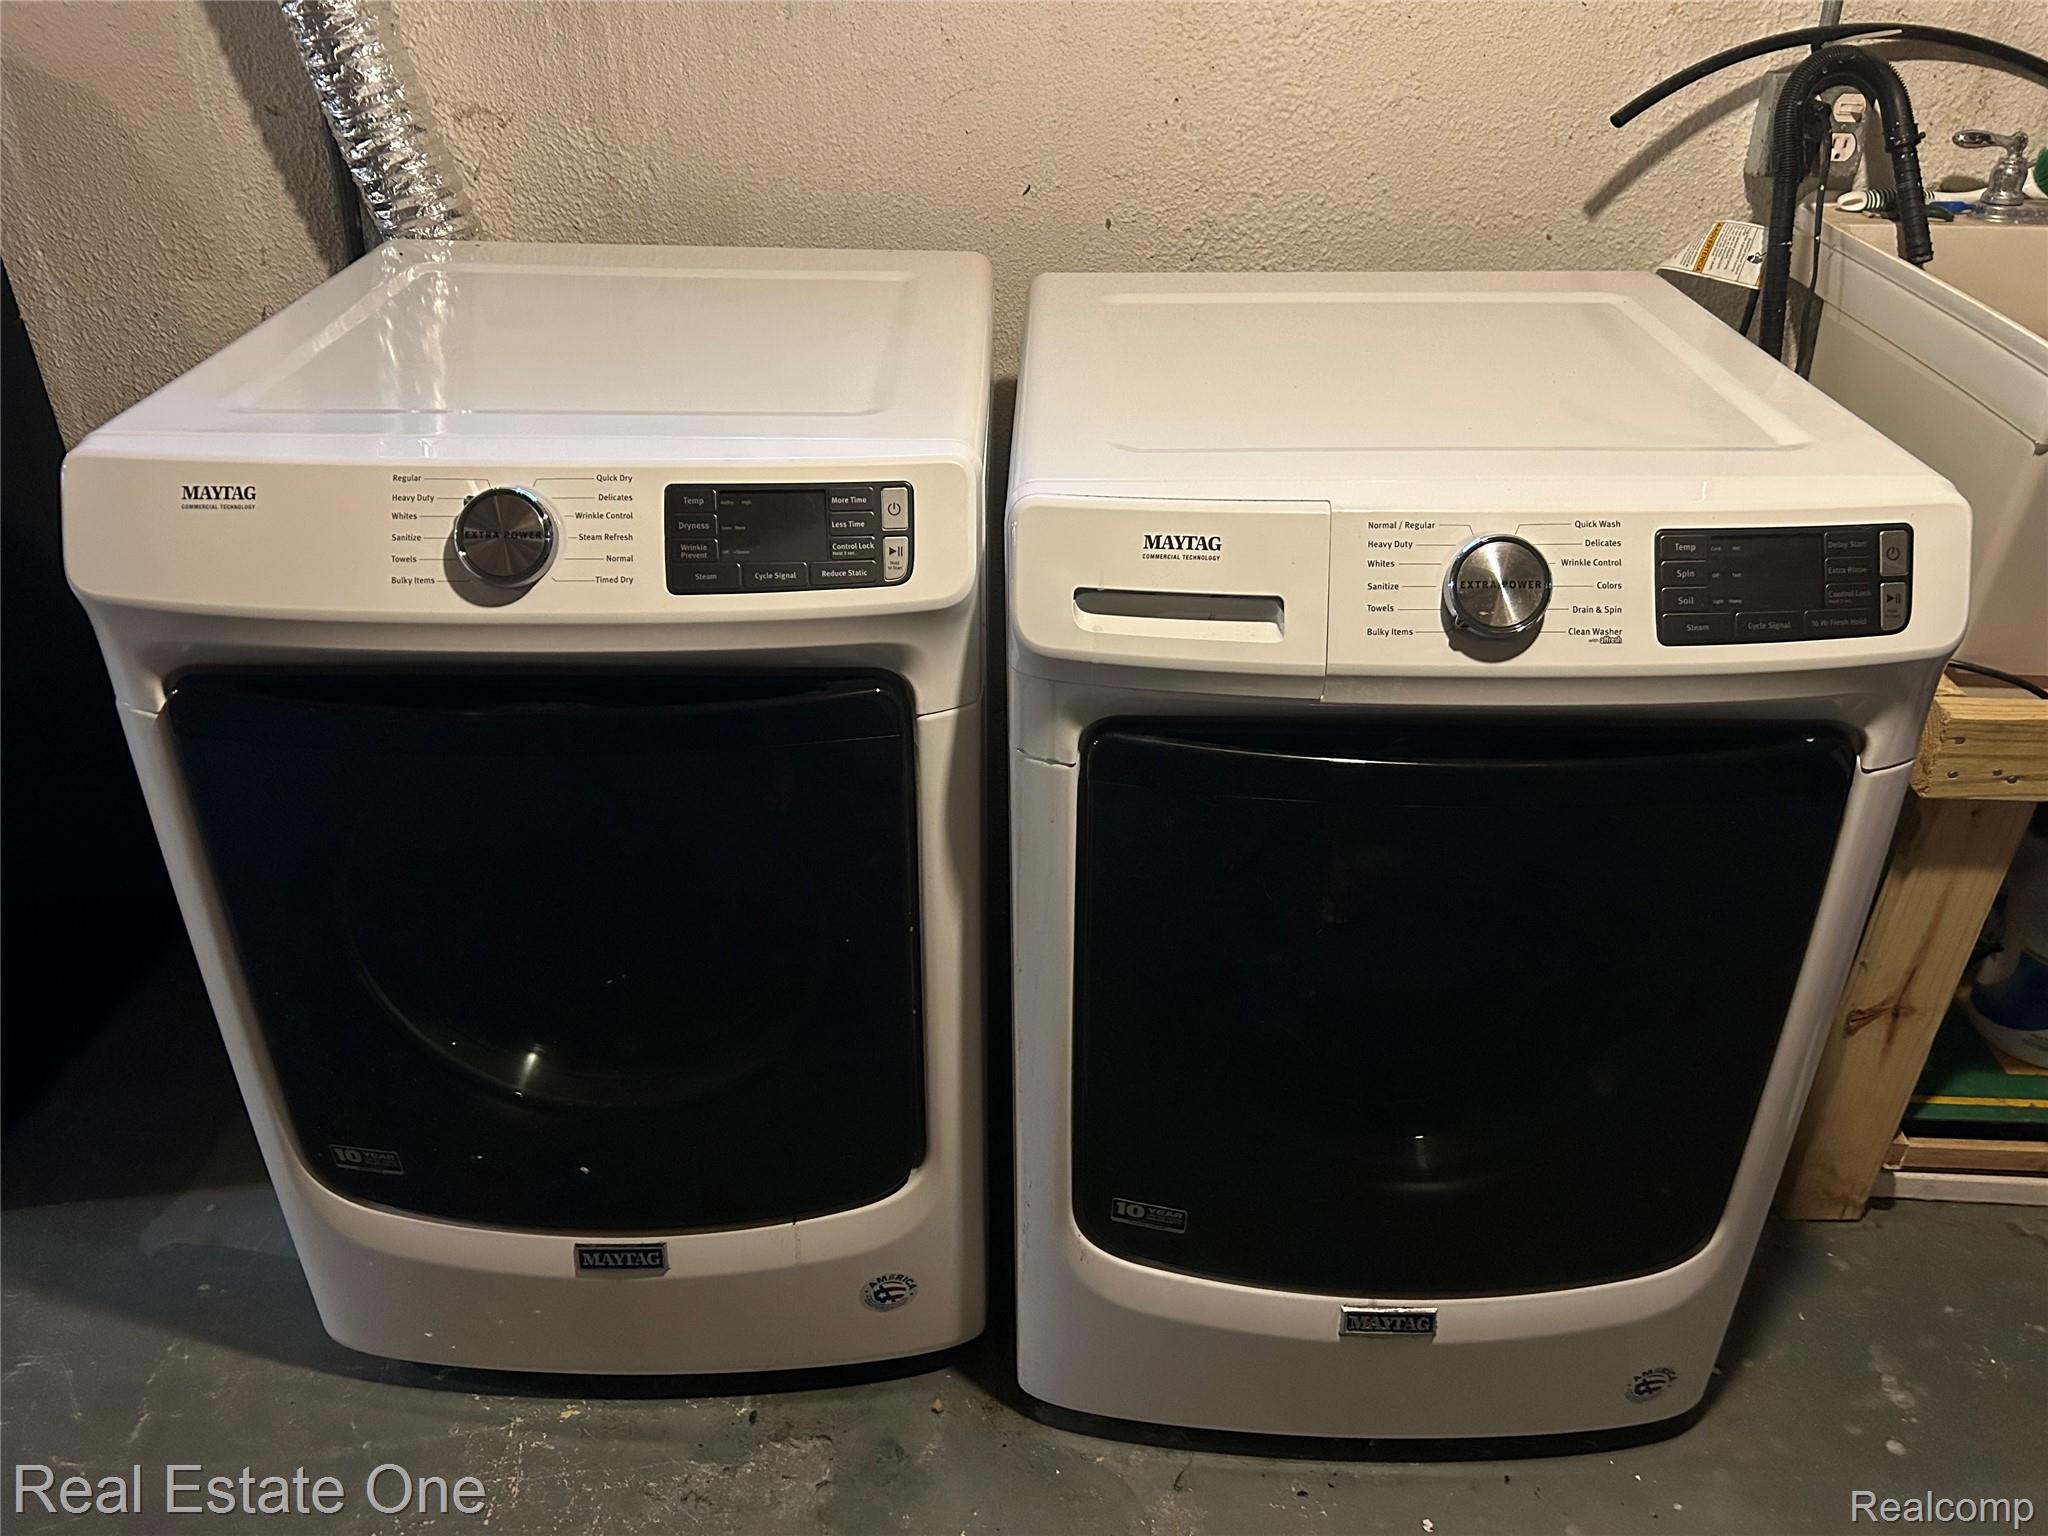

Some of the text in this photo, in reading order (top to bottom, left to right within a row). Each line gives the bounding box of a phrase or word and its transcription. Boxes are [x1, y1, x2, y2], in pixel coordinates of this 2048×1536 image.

[392, 474, 422, 483] Regular
[596, 474, 633, 483] Quick Dry
[182, 486, 256, 500] MAYTAG
[392, 494, 435, 503] Heavy Duty
[683, 496, 705, 506] Temp
[831, 496, 867, 504] More Time
[391, 512, 418, 520] Whites
[575, 512, 633, 520] Wrinkle Control
[678, 522, 710, 531] Dryness
[1368, 521, 1436, 530] Normal / Regular
[1574, 521, 1597, 529] Quick
[391, 533, 422, 542] Sanitize
[465, 530, 542, 539] EXTRA POWER
[578, 533, 633, 541] Steam Refresh
[832, 542, 875, 551] Control Lock
[1143, 535, 1222, 551] MAYTAG
[1367, 540, 1413, 549] Heavy Duty
[1585, 539, 1622, 547] Delicates
[1674, 543, 1696, 553] Temp
[391, 555, 417, 563] Towels
[1561, 559, 1622, 567] Wrinkle Control
[1367, 560, 1395, 568] Whites
[755, 571, 797, 581] Cycle Signal
[848, 569, 868, 577] Static
[1676, 569, 1695, 579] Spin
[391, 576, 412, 585] Bulky
[595, 576, 634, 585] Timed Dry
[1460, 580, 1542, 589] EXTRA POWER
[1596, 581, 1622, 590] Colors
[1678, 596, 1694, 605] Soil
[1367, 604, 1395, 612] Towels
[1604, 606, 1622, 615] Spin
[1686, 623, 1709, 632] Steam
[1747, 621, 1792, 630] Cycle Signal
[1367, 628, 1414, 637] Bulky Items
[1568, 628, 1623, 636] Clean Washer
[334, 1148, 362, 1163] 10
[1116, 1202, 1145, 1218] 10
[582, 1252, 660, 1266] MAYTAG
[869, 1273, 917, 1290] AMERICA
[1348, 1315, 1430, 1331] MAYTAG
